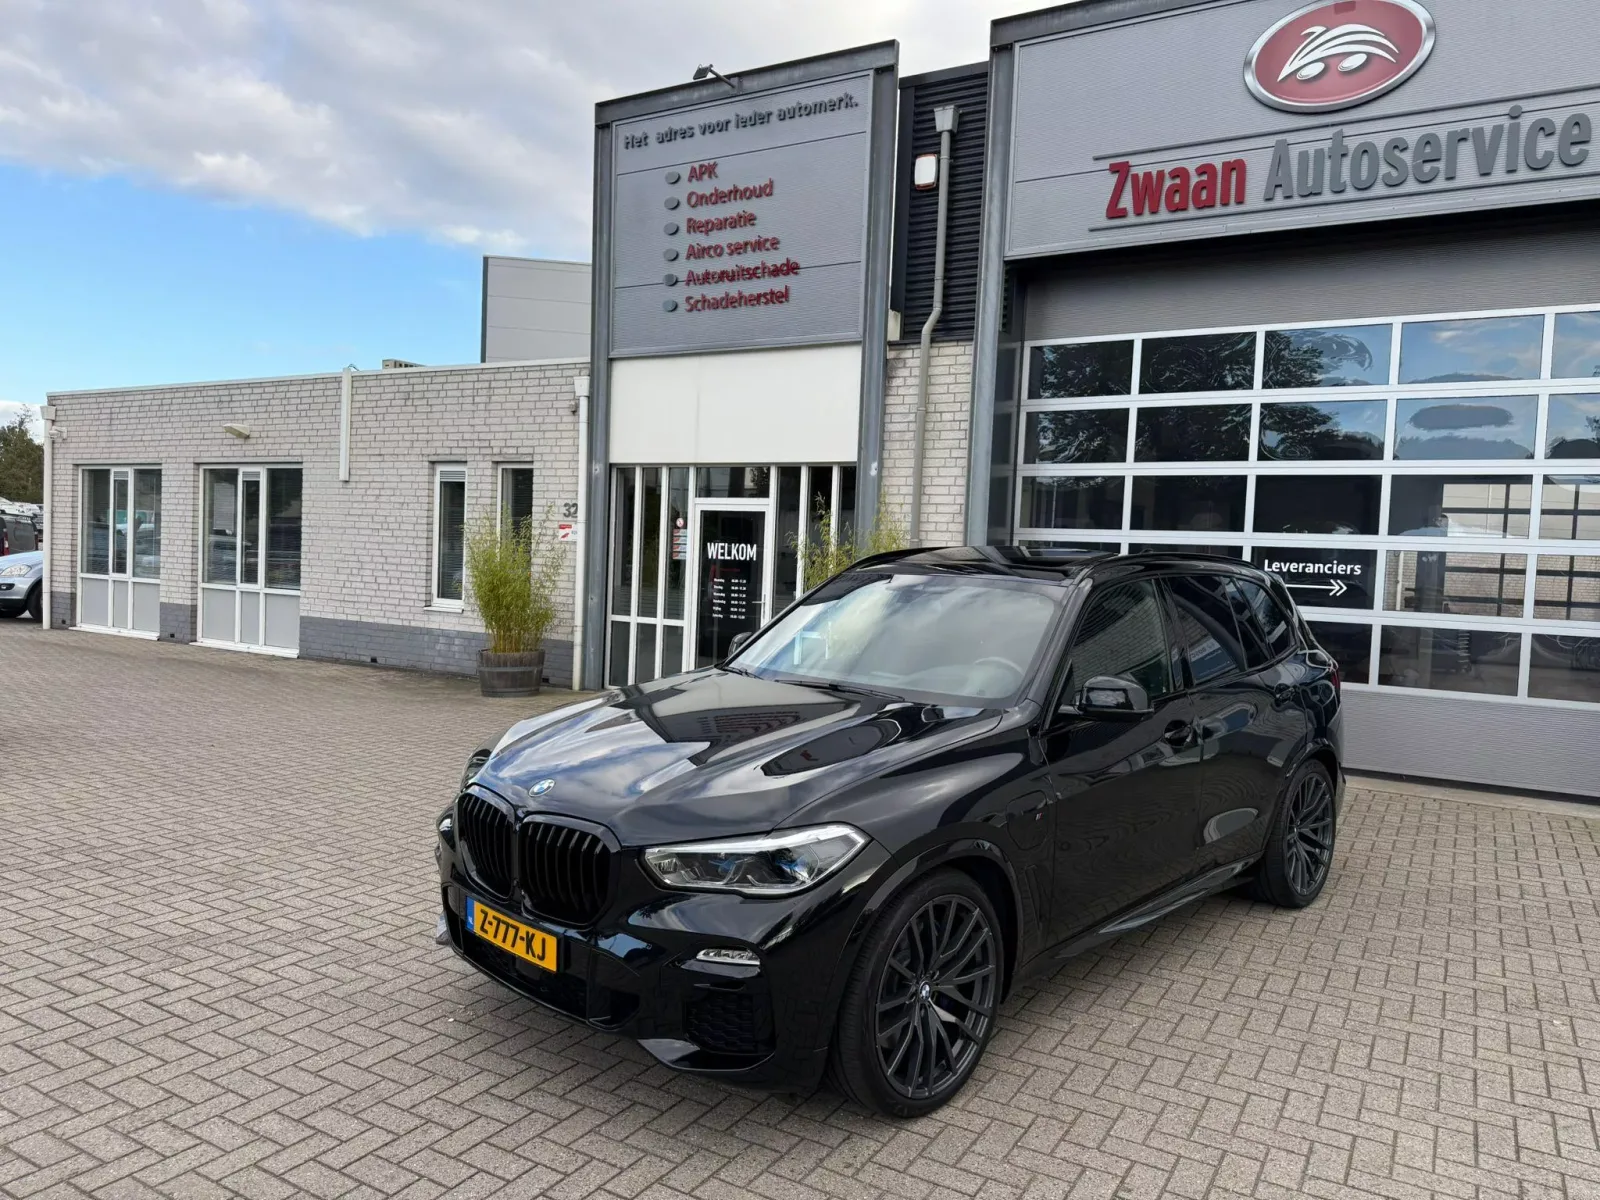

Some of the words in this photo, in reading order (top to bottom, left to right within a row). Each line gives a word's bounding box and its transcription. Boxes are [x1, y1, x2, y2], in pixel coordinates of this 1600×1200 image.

[624, 132, 649, 150] Het
[655, 121, 695, 144] adres
[699, 118, 731, 136] voor
[734, 110, 773, 130] ieder
[776, 92, 859, 121] automerk.
[687, 161, 719, 183] APK
[1105, 157, 1247, 220] Zwaan
[1263, 104, 1593, 201] Autoservice
[686, 178, 774, 209] Onderhoud
[685, 210, 757, 237] Reparatie
[685, 241, 724, 261] Airco
[726, 235, 781, 257] service
[684, 257, 801, 287] Autoruitschade
[684, 284, 791, 313] Schadeherstel
[563, 502, 578, 518] 32
[706, 542, 757, 561] WELKOM
[1263, 559, 1362, 575] Leveranciers
[480, 908, 547, 962] Z-777-KJ
